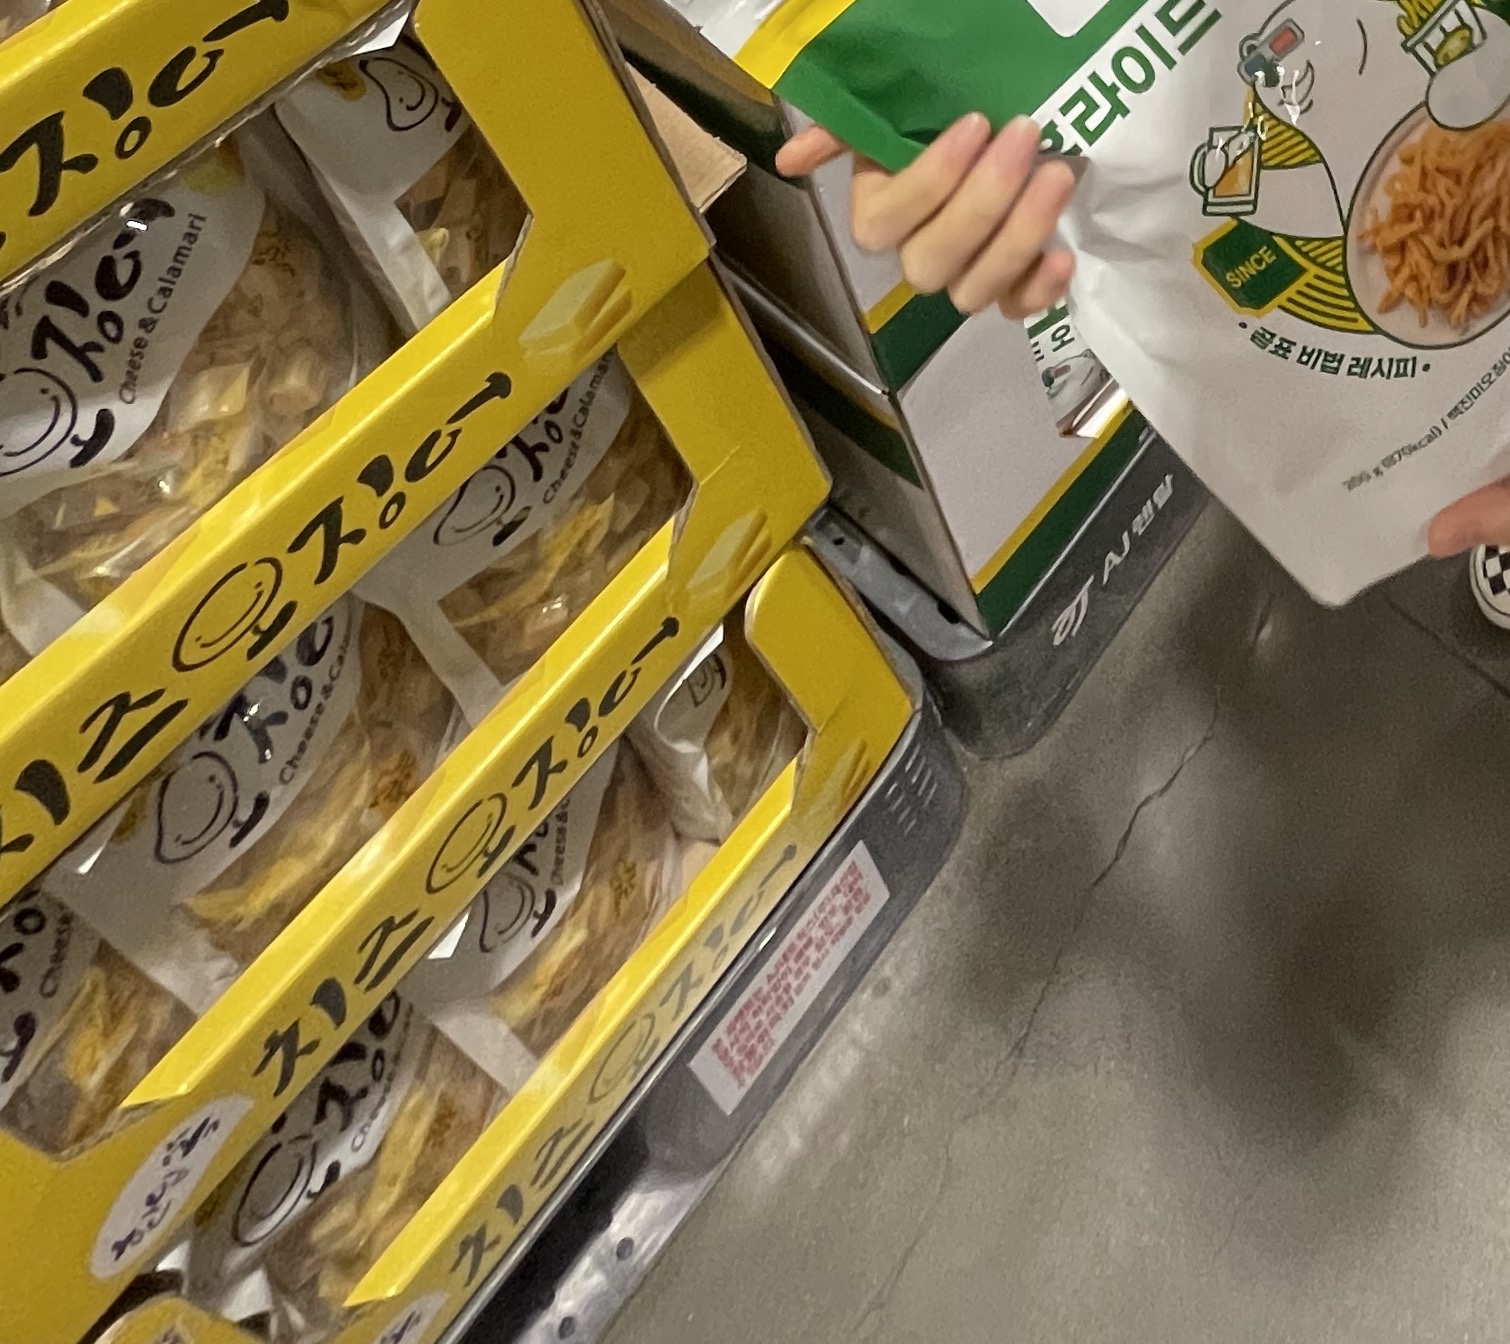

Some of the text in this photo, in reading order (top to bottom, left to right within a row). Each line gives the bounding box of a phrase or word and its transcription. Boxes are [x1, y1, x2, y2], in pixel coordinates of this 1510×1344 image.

[1224, 246, 1279, 291] SINCE
[1249, 325, 1418, 381] 곰표 비법 레시피
